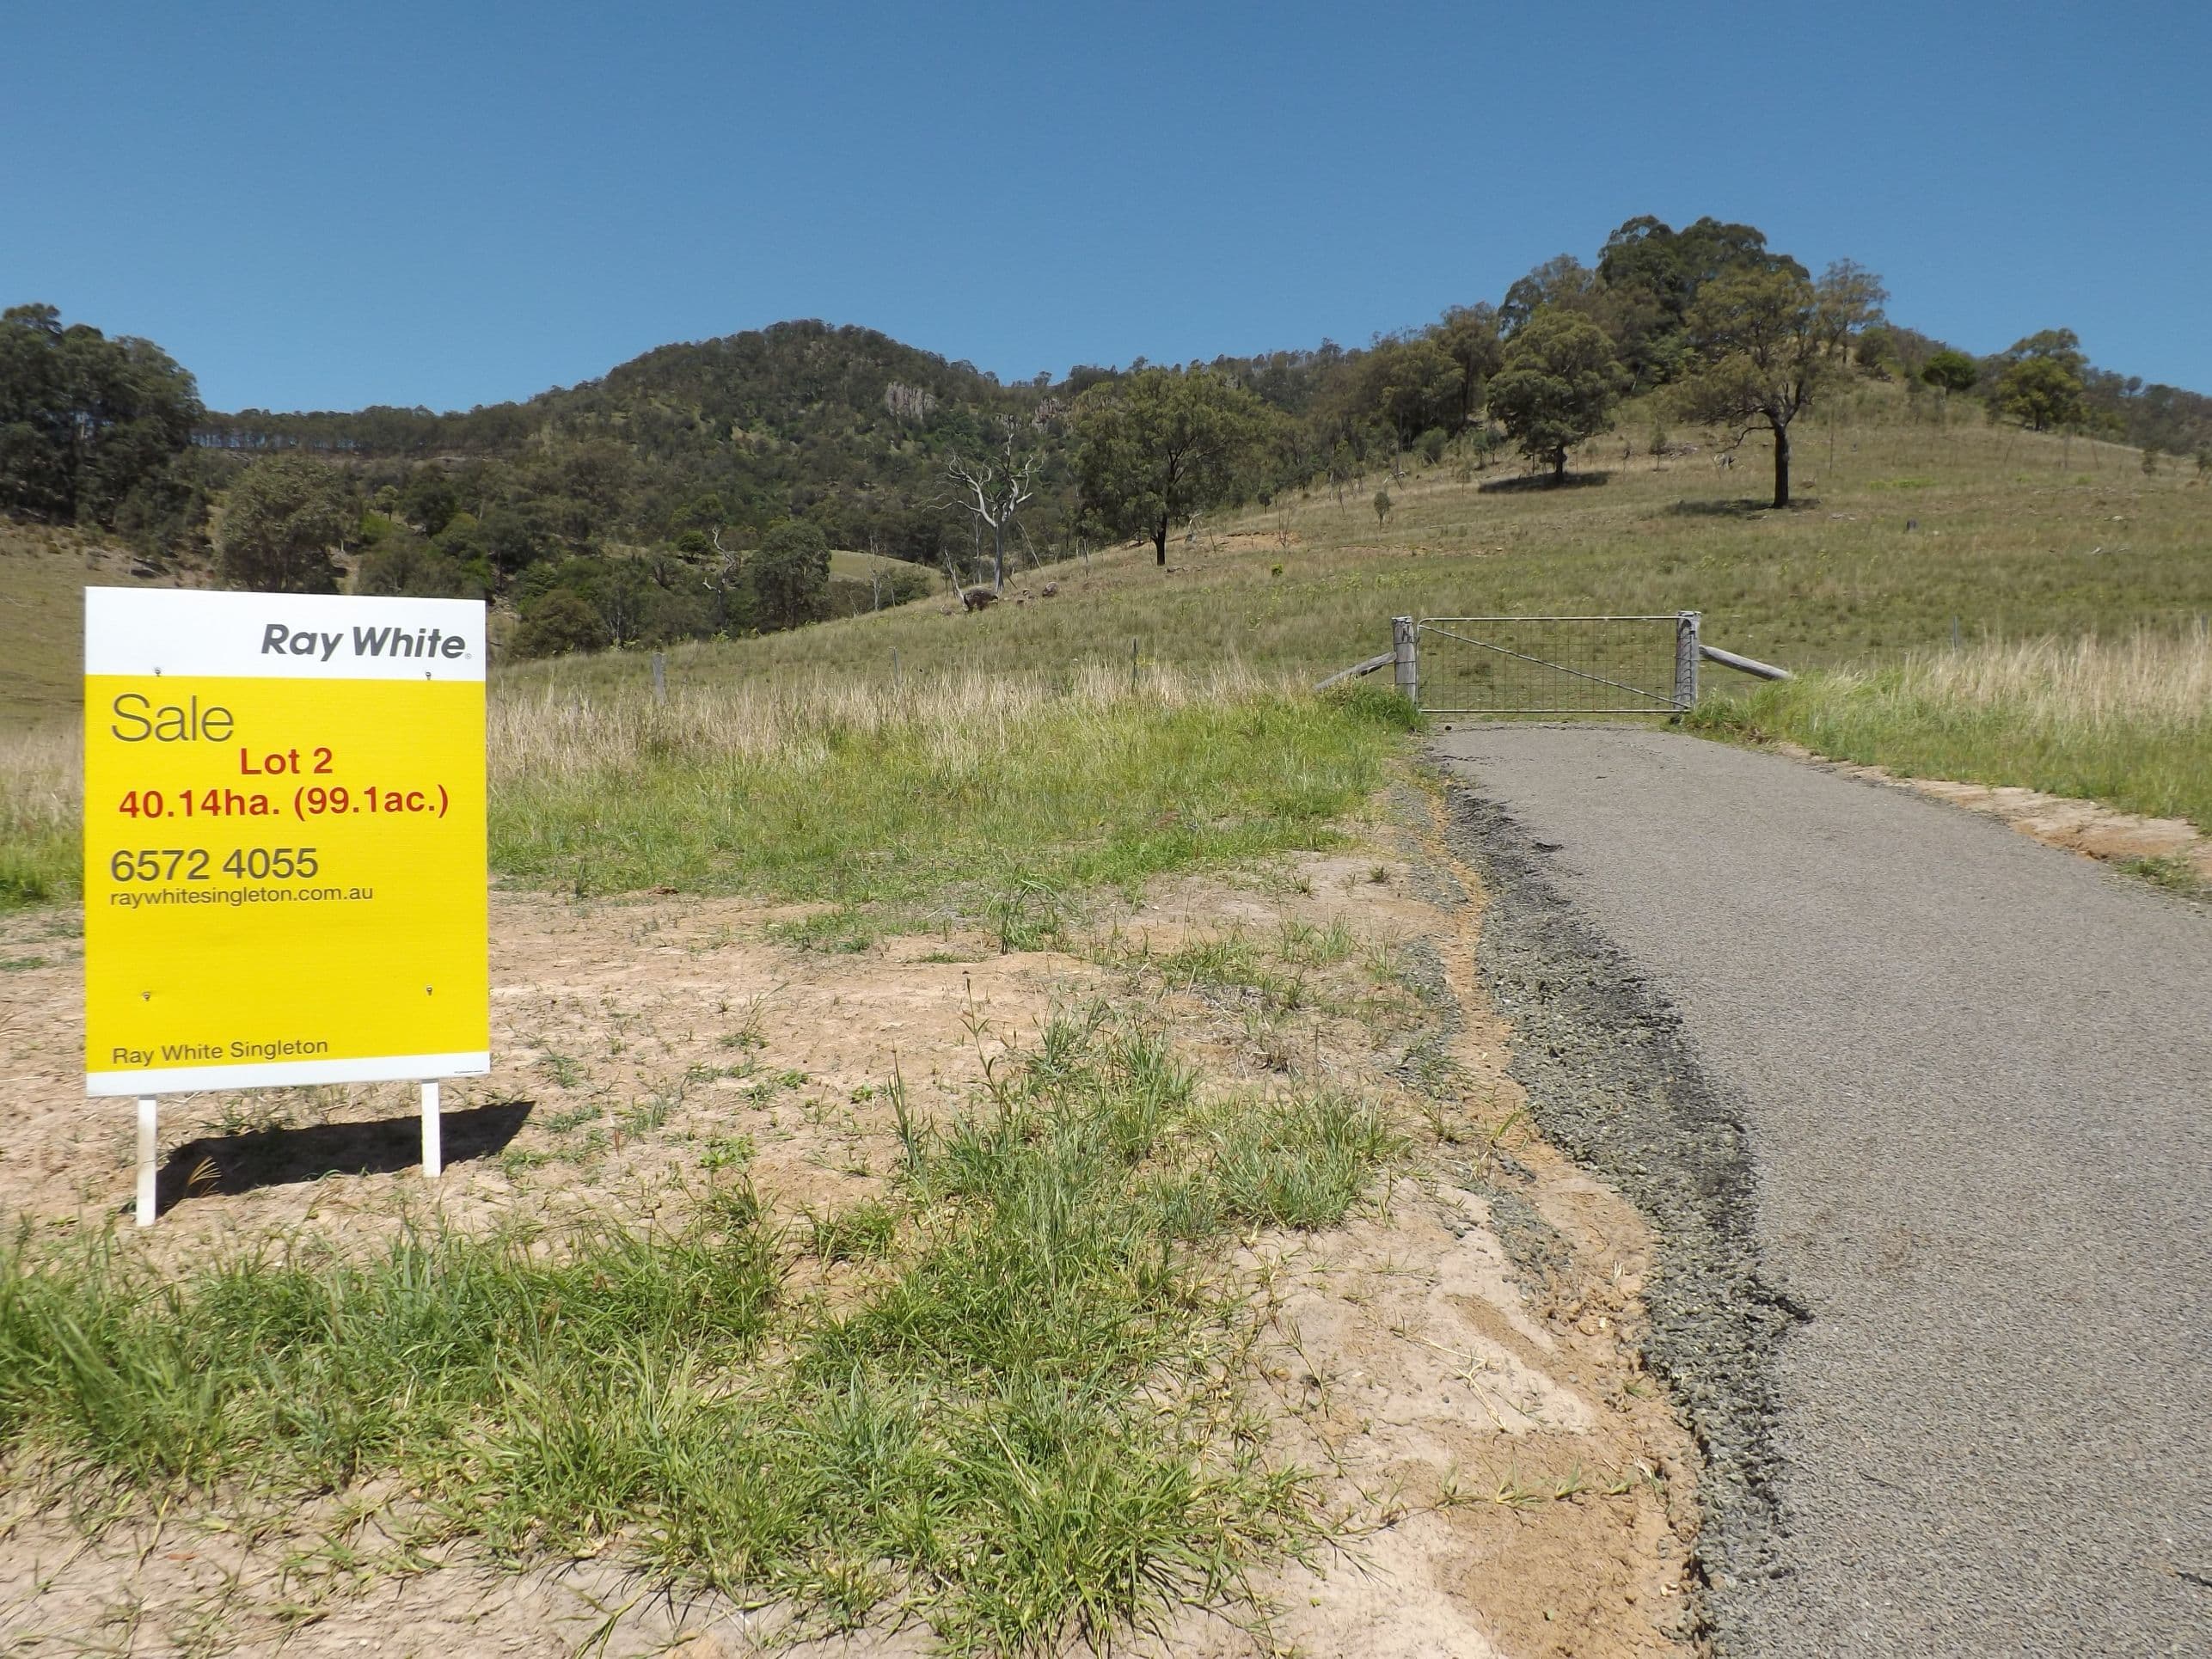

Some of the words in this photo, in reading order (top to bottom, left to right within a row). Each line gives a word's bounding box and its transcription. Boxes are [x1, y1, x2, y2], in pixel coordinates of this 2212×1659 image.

[260, 623, 344, 662] Ray
[353, 626, 466, 659] White
[111, 694, 234, 742] Sale
[240, 748, 301, 775] Lot
[313, 747, 333, 774] 2
[119, 789, 280, 818] 40.14ha.
[294, 784, 449, 822] (99.1ac.)
[110, 848, 210, 882] 6572
[222, 848, 319, 879] 4055
[110, 885, 373, 909] raywhitesingleton.com.au
[112, 1047, 154, 1067] Ray
[162, 1044, 223, 1062] White
[230, 1038, 328, 1060] Singleton
